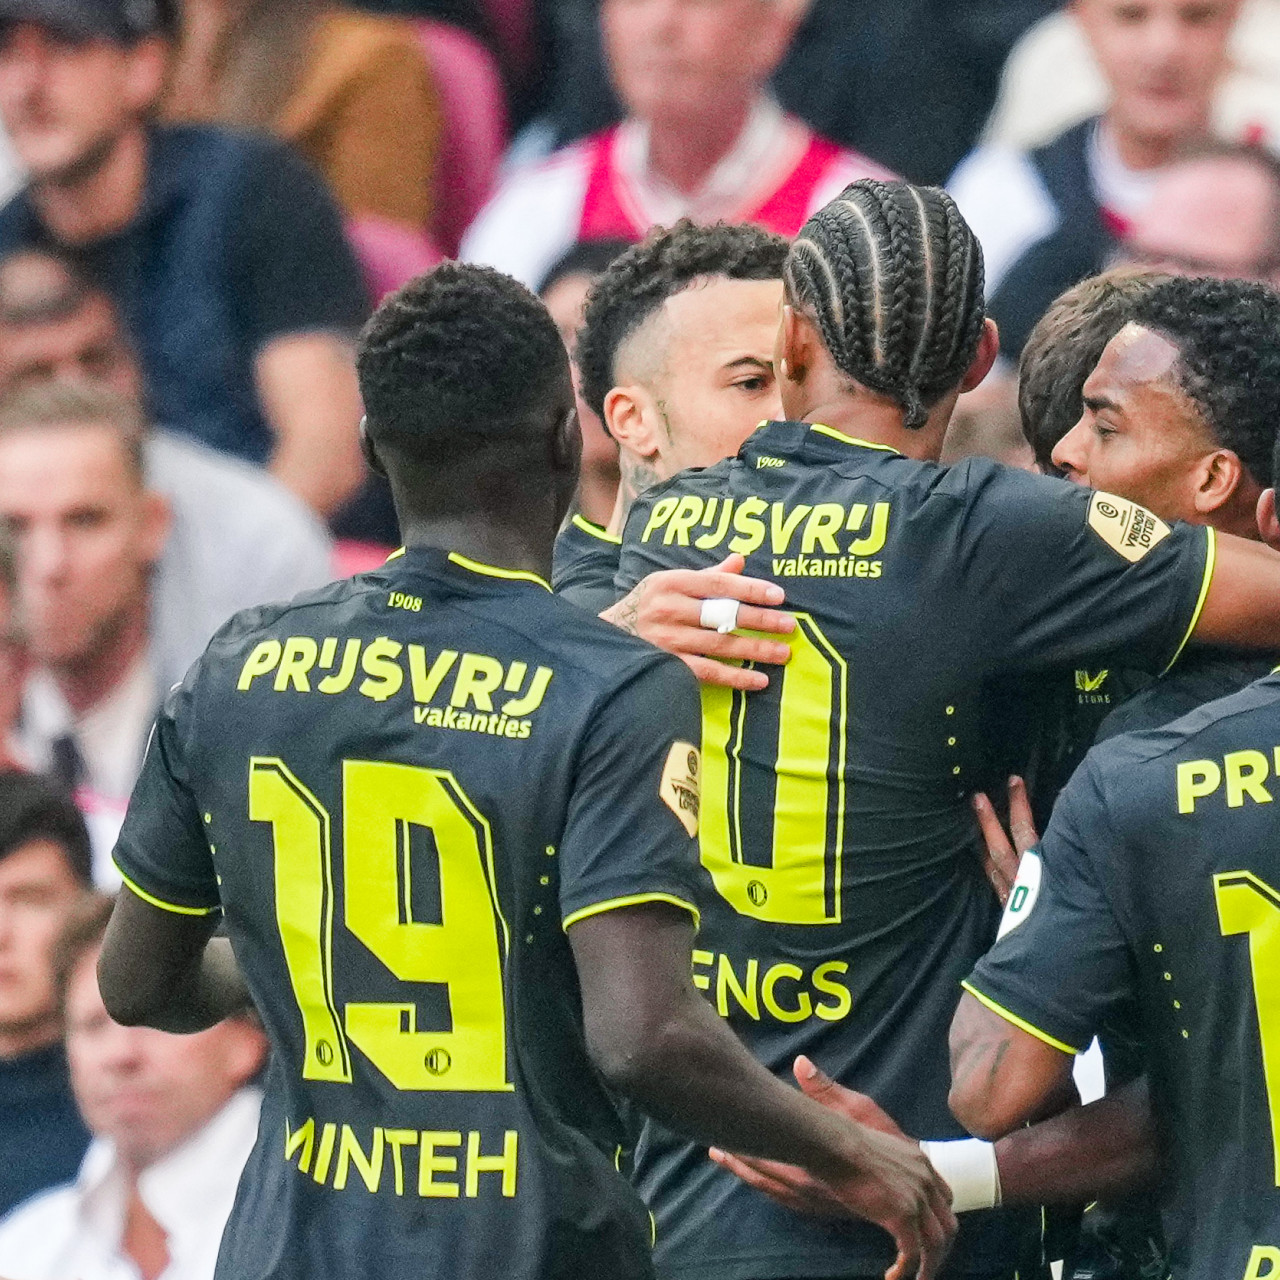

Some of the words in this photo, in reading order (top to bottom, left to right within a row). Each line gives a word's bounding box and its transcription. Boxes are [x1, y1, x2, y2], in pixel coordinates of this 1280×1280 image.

[771, 552, 883, 579] vakanties
[387, 591, 423, 613] 1908
[413, 703, 532, 739] vakanties
[248, 755, 516, 1092] 19
[284, 1116, 519, 1198] MINTEH
